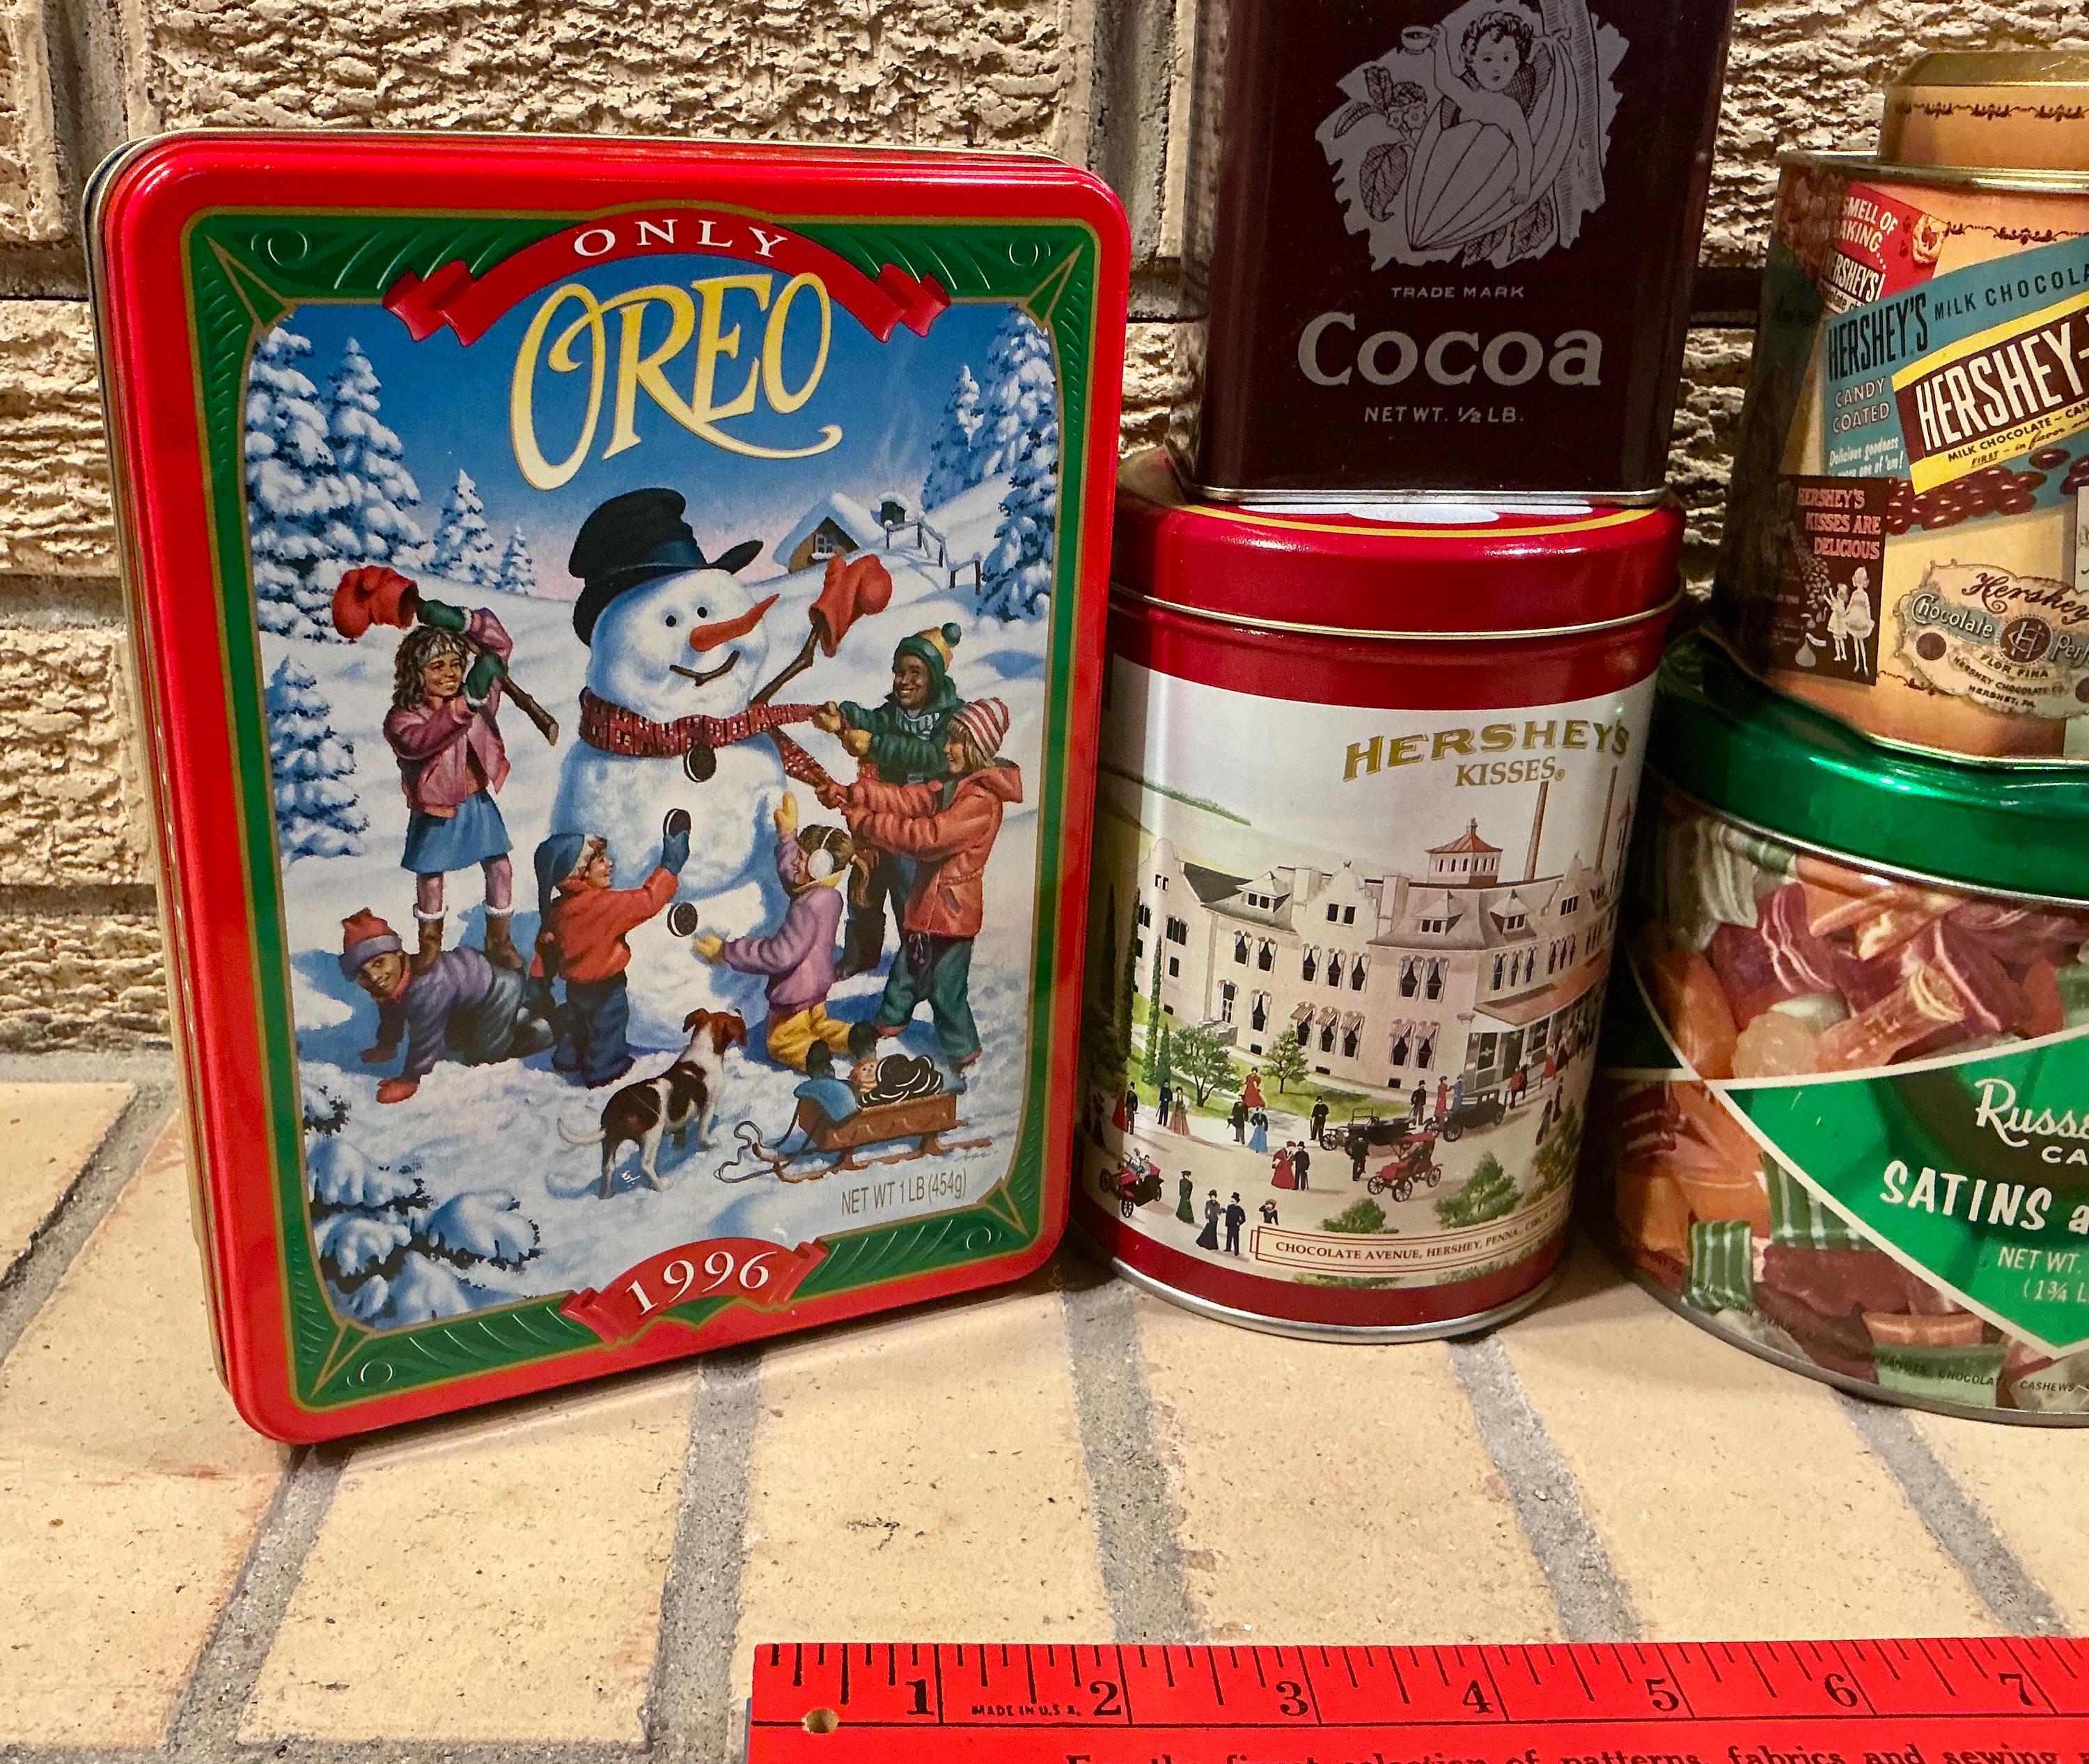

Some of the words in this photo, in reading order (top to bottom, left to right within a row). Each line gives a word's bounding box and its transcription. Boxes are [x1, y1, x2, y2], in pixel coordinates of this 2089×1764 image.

[573, 219, 788, 258] ONLY
[1880, 211, 1899, 235] OF
[1391, 286, 1455, 299] TRADE
[1464, 286, 1524, 299] MARK
[1297, 311, 1603, 387] Cocoa
[1828, 292, 1928, 382] HERSHEY'S
[1934, 292, 1976, 322] MILK
[510, 272, 843, 491] OREO
[1835, 375, 1886, 408] CANDY
[1916, 312, 2089, 451] HERSHEY-
[1364, 406, 1407, 423] NET
[1413, 406, 1448, 423] WT.
[1487, 406, 1524, 423] LB.
[1832, 401, 1891, 434] COATED
[1829, 445, 1862, 467] Delicious
[1864, 437, 1899, 461] goodness
[1948, 445, 1976, 462] MILK
[1980, 416, 2052, 451] CHOCOLATE
[1875, 455, 1884, 474] of
[1797, 487, 1865, 509] HERSHEY'S
[1806, 512, 1850, 532] KISSES
[1852, 515, 1881, 534] ARE
[1814, 537, 1880, 559] DELICIOUS
[1911, 593, 1994, 639] Chocolate
[1954, 656, 1994, 685] HERSHEY
[1995, 681, 2048, 696] CHOCOLATE
[1980, 654, 2012, 674] FLOR
[2017, 668, 2049, 678] FINA
[1343, 719, 1631, 781] HERSHEY'S
[2041, 1145, 2088, 1166] CA
[841, 1187, 870, 1216] NET
[874, 1181, 895, 1209] WT
[900, 1180, 905, 1204] 1
[908, 1176, 925, 1203] LB
[928, 1167, 967, 1205] (454g)
[1879, 1160, 2052, 1231] SATINS
[1276, 1241, 1361, 1260] CHOCOLATE
[1364, 1249, 1423, 1260] AVENUE,
[1426, 1240, 1483, 1258] HERSHEY,
[1997, 1246, 2043, 1270] NET
[2047, 1251, 2082, 1274] WT.
[625, 1251, 778, 1316] 1996
[905, 1679, 934, 1716] 1
[1089, 1680, 1122, 1717] 2
[1274, 1680, 1309, 1717] 3
[1462, 1679, 1493, 1715] 4
[1646, 1678, 1680, 1712] 5
[1824, 1673, 1859, 1708] 6
[1998, 1673, 2035, 1706] 7
[971, 1704, 1015, 1717] MADE
[1019, 1705, 1034, 1715] IN
